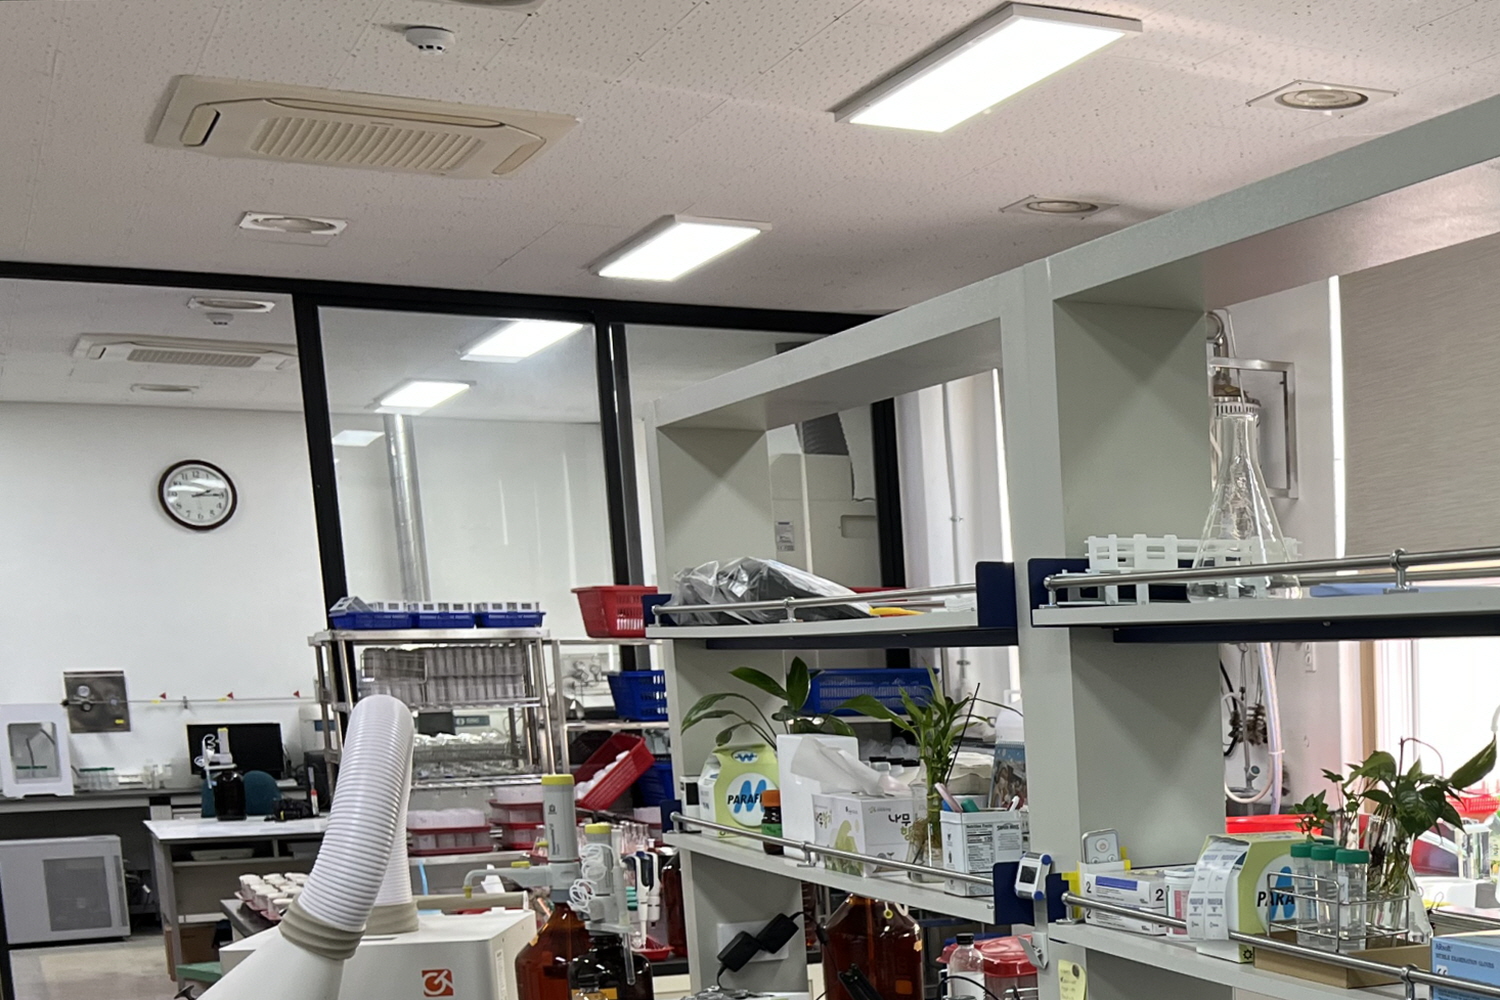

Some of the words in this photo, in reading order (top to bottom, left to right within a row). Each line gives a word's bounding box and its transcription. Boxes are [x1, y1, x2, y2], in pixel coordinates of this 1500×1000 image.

[192, 471, 200, 479] 12
[727, 793, 762, 805] PARAFI
[1086, 881, 1092, 894] 2
[1155, 888, 1165, 902] 2
